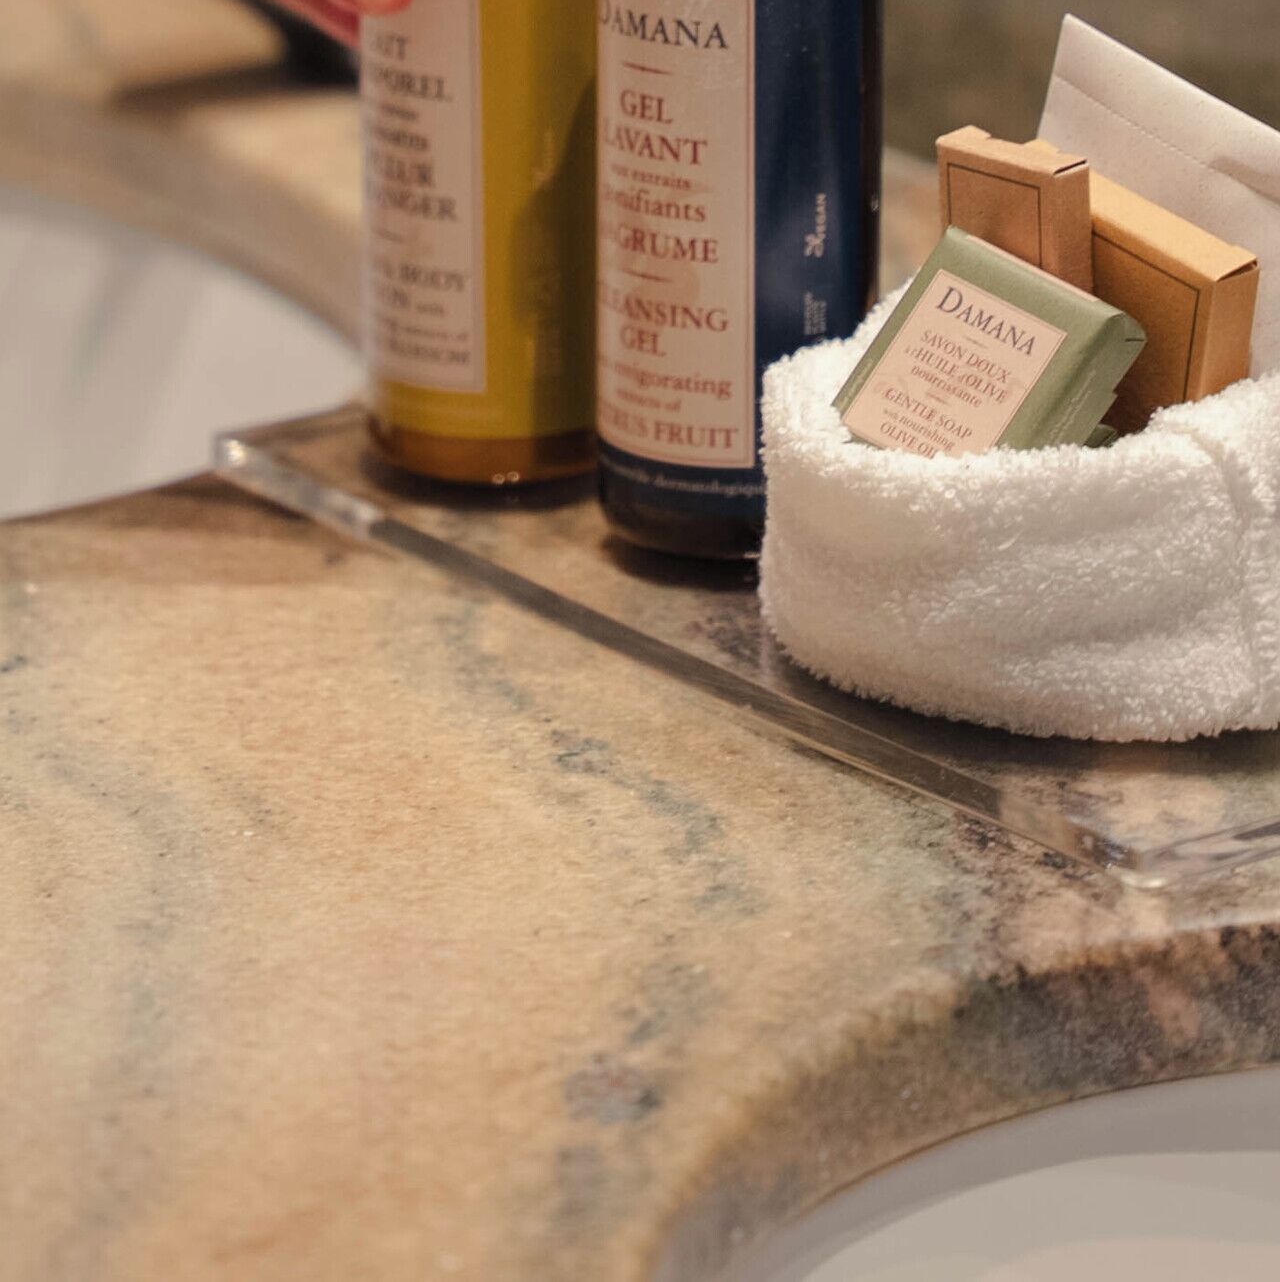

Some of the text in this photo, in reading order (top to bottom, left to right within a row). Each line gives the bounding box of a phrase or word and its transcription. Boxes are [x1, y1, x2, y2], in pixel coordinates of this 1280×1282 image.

[621, 88, 673, 124] GEL
[936, 286, 1038, 356] DAMANA
[620, 324, 667, 358] GEL
[921, 329, 1012, 384] SAVON DOUX
[884, 387, 937, 423] GENTLE
[935, 414, 974, 440] SOAP
[653, 420, 739, 450] FRUIT
[880, 421, 918, 449] OLIVE
[898, 414, 956, 453] nourishing
